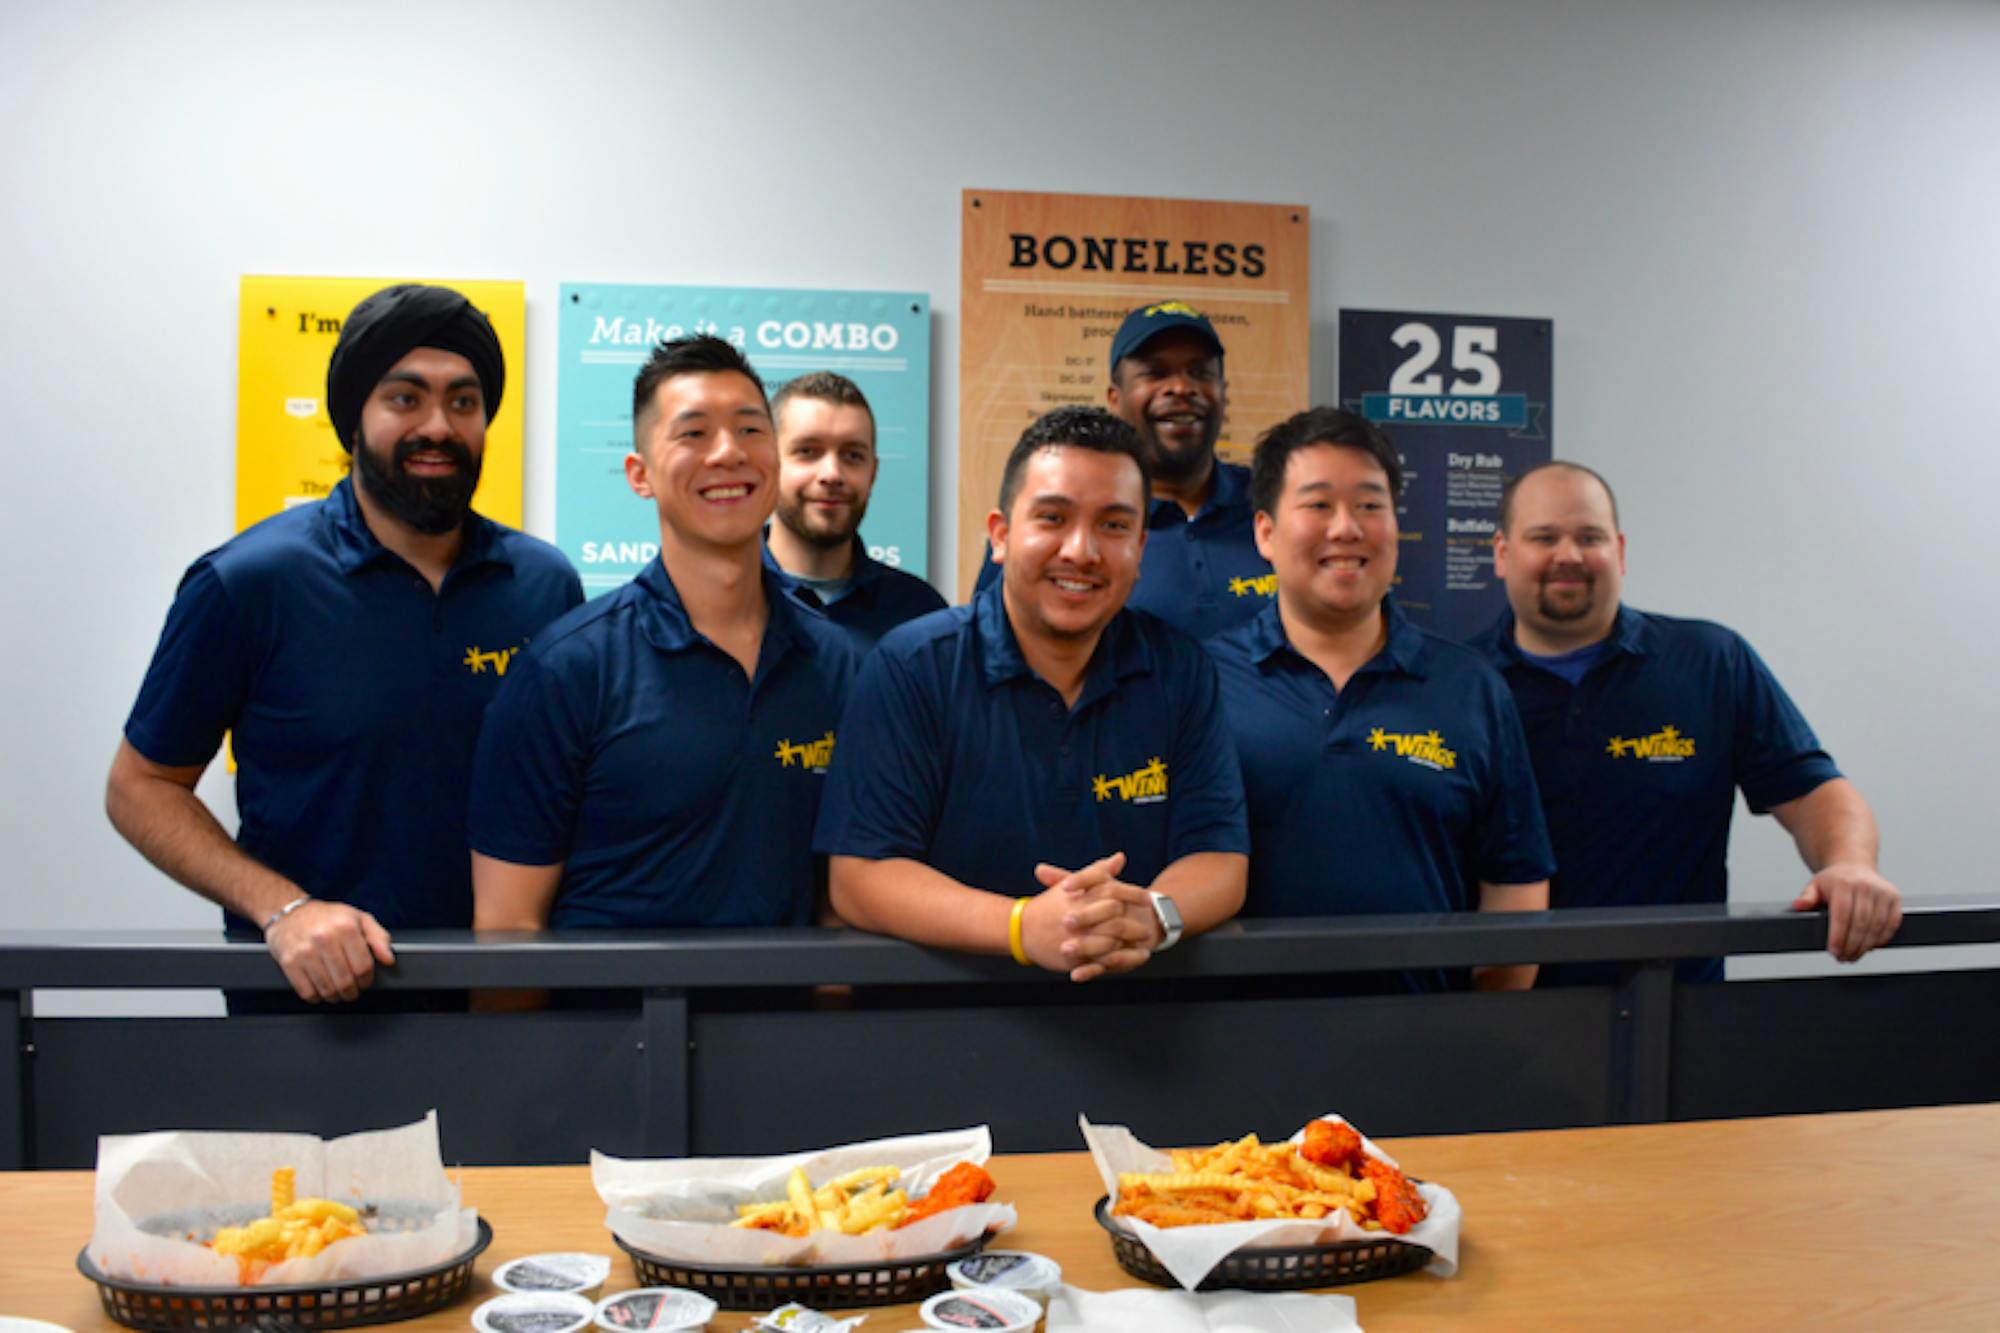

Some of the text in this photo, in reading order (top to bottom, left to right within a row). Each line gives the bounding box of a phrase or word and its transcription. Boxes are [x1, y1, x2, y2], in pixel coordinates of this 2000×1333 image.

[1009, 233, 1266, 278] BONELESS
[1024, 304, 1065, 318] Hand
[589, 317, 684, 346] Make
[757, 320, 898, 351] COMBO
[1389, 322, 1502, 396] 25
[1389, 398, 1501, 422] FLAVORS
[582, 542, 660, 564] SAND
